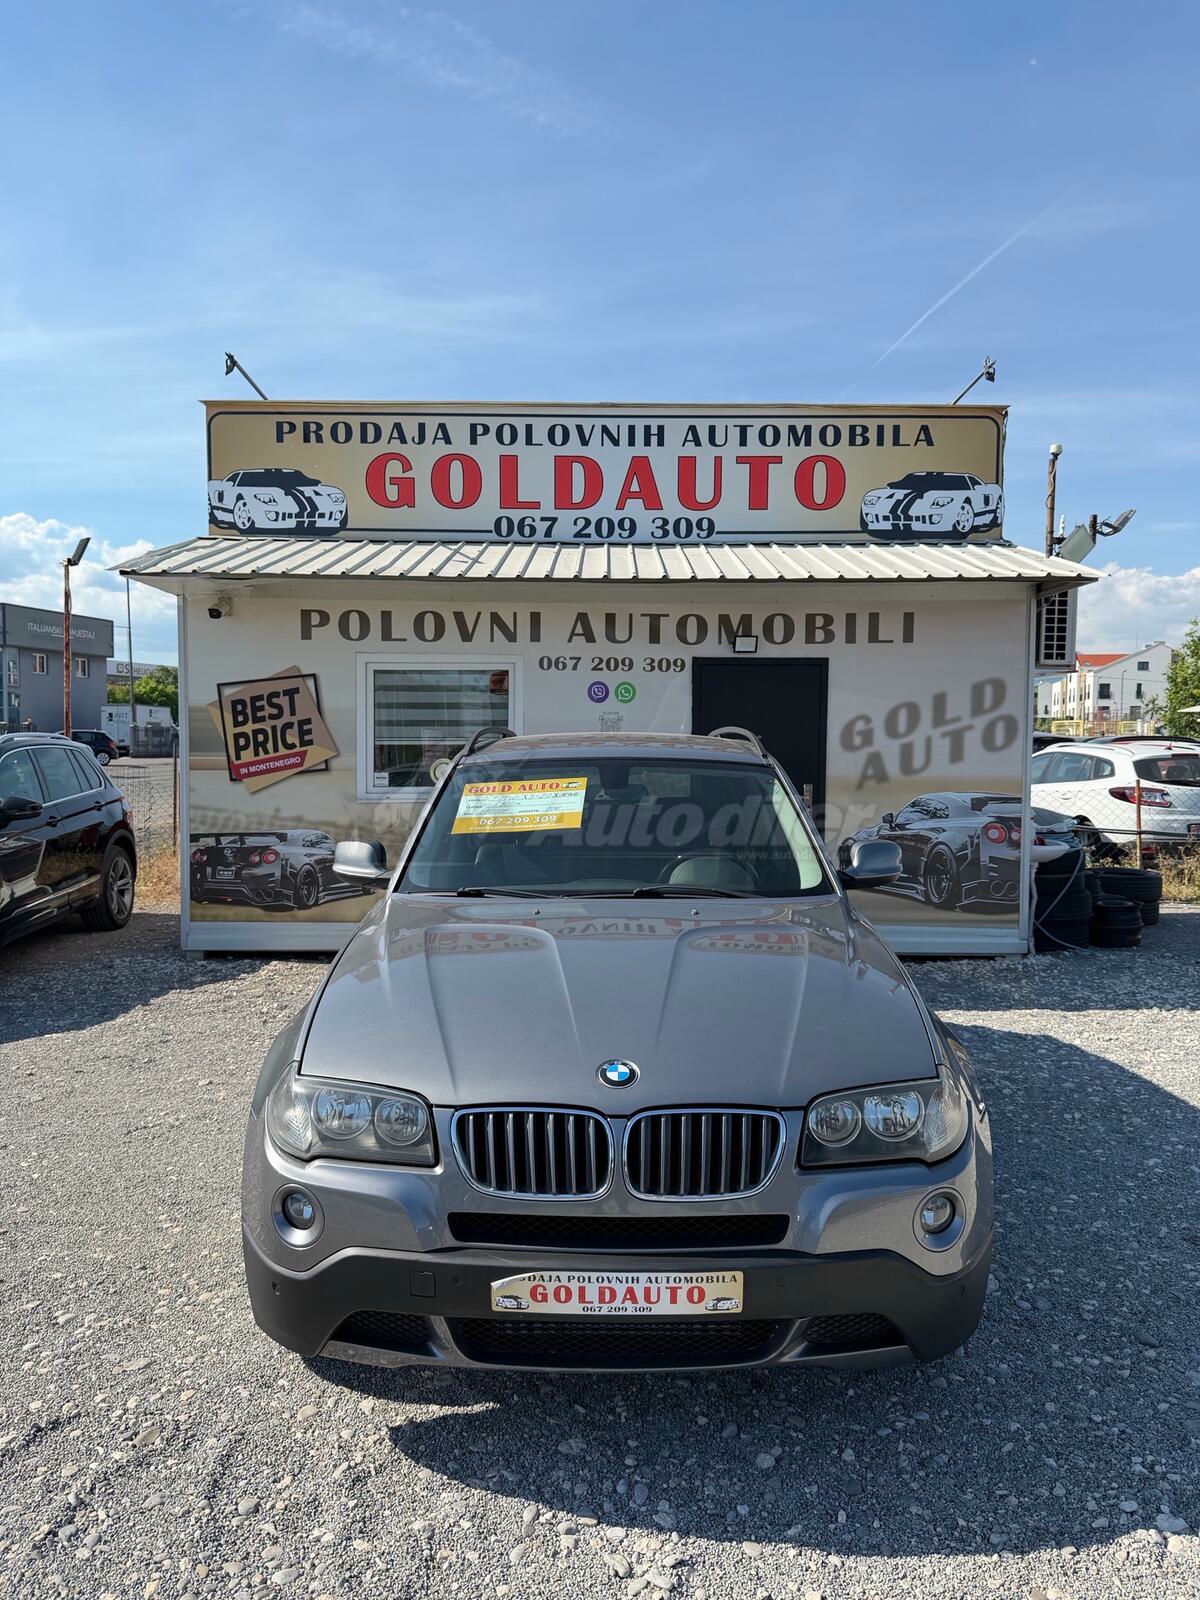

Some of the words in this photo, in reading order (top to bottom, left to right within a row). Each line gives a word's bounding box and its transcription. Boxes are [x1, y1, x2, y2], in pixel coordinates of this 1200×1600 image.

[275, 420, 453, 446] PRODAJA
[469, 422, 665, 447] POLOVNIH
[682, 423, 935, 447] AUTOMOBILA
[365, 452, 847, 512] GOLDAUTO
[493, 515, 559, 539] 067
[572, 516, 637, 540] 209
[650, 516, 716, 540] 309
[300, 608, 542, 643] POLOVNI
[566, 611, 915, 646] AUTOMOBILI
[538, 655, 582, 672] 067
[590, 656, 634, 673] 209
[642, 656, 686, 673] 309
[231, 687, 300, 728] BEST
[839, 677, 1007, 753] GOLD
[233, 717, 314, 761] PRICE
[249, 756, 301, 772] MONTENEGRO
[856, 714, 1019, 790] AUTO
[468, 784, 513, 794] GOLD
[517, 782, 561, 792] AUTO
[533, 815, 557, 823] 309
[520, 1274, 562, 1284] DAJA
[567, 1275, 640, 1284] POLOVNIH
[645, 1274, 738, 1284] AUTOMOBILA
[529, 1284, 706, 1305] GOLDAUTO
[582, 1305, 603, 1313] 067
[606, 1305, 628, 1313] 209
[631, 1305, 653, 1313] 309
